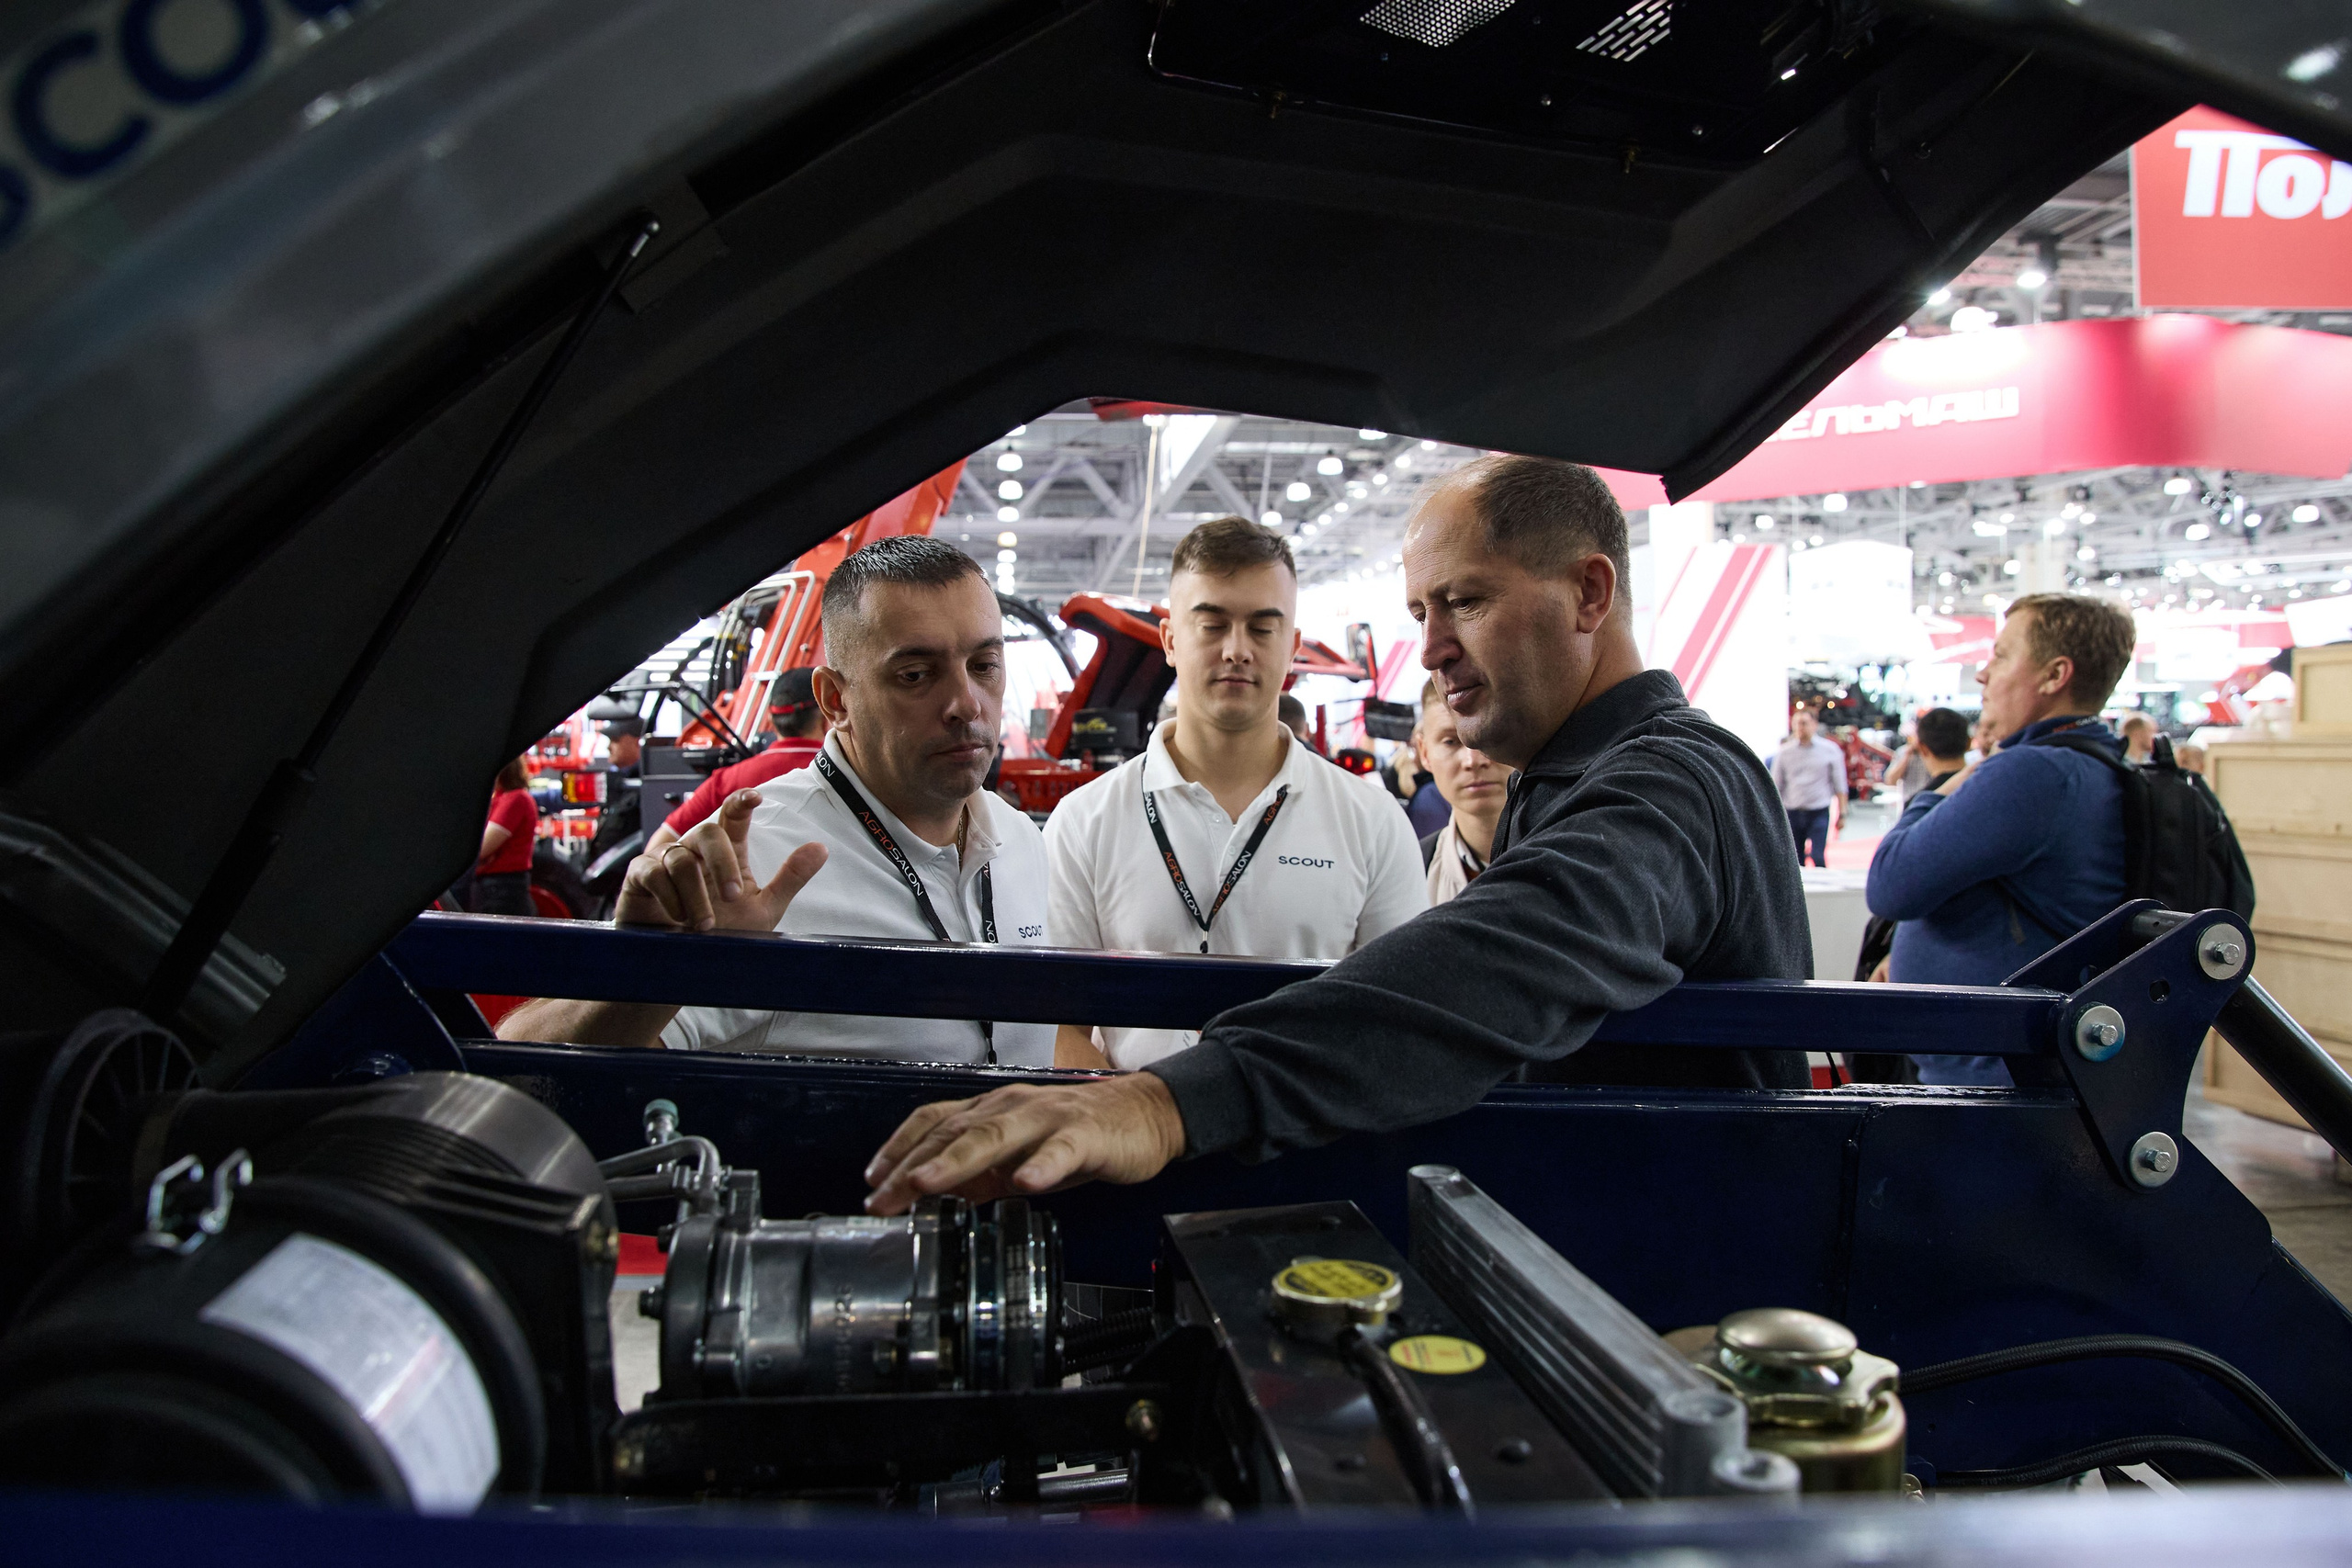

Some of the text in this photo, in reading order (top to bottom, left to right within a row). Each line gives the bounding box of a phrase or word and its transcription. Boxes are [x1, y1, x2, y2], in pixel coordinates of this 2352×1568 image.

[1762, 387, 2019, 443] ЕЛЬМАШ
[858, 811, 924, 897] AGROSALON
[1278, 855, 1335, 869] SCOUT
[1163, 852, 1200, 917] AGROSALON
